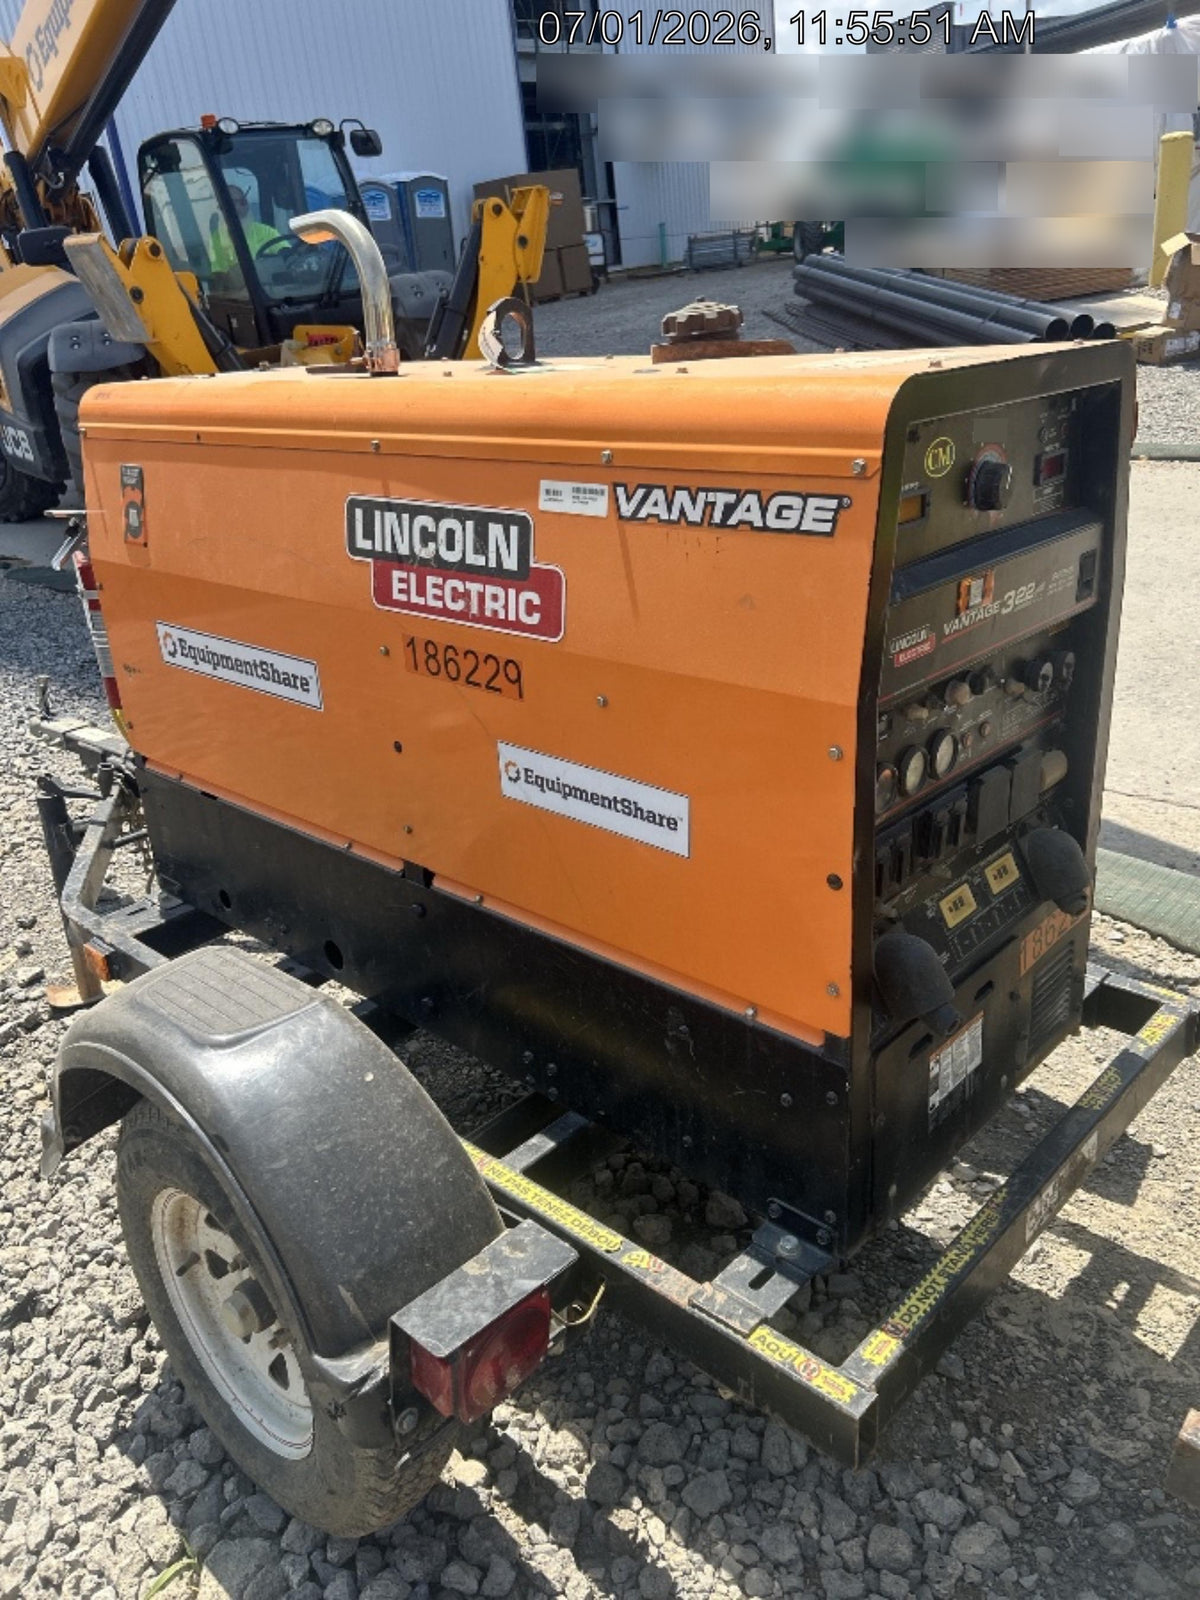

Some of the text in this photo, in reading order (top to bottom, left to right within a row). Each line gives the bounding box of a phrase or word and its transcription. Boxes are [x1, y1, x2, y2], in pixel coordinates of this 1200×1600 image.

[355, 508, 519, 571] LINCOLN
[391, 569, 542, 625] ELECTRIC
[943, 600, 1001, 635] VANTAGE
[177, 637, 310, 695] EquipmentShare
[405, 636, 524, 699] 186229
[523, 768, 678, 832] EquipmentShare
[487, 1165, 506, 1181] NE
[531, 1194, 573, 1220] TENEZ
[900, 1303, 921, 1325] DO
[921, 1278, 942, 1305] NOT
[971, 1213, 999, 1246] HERE
